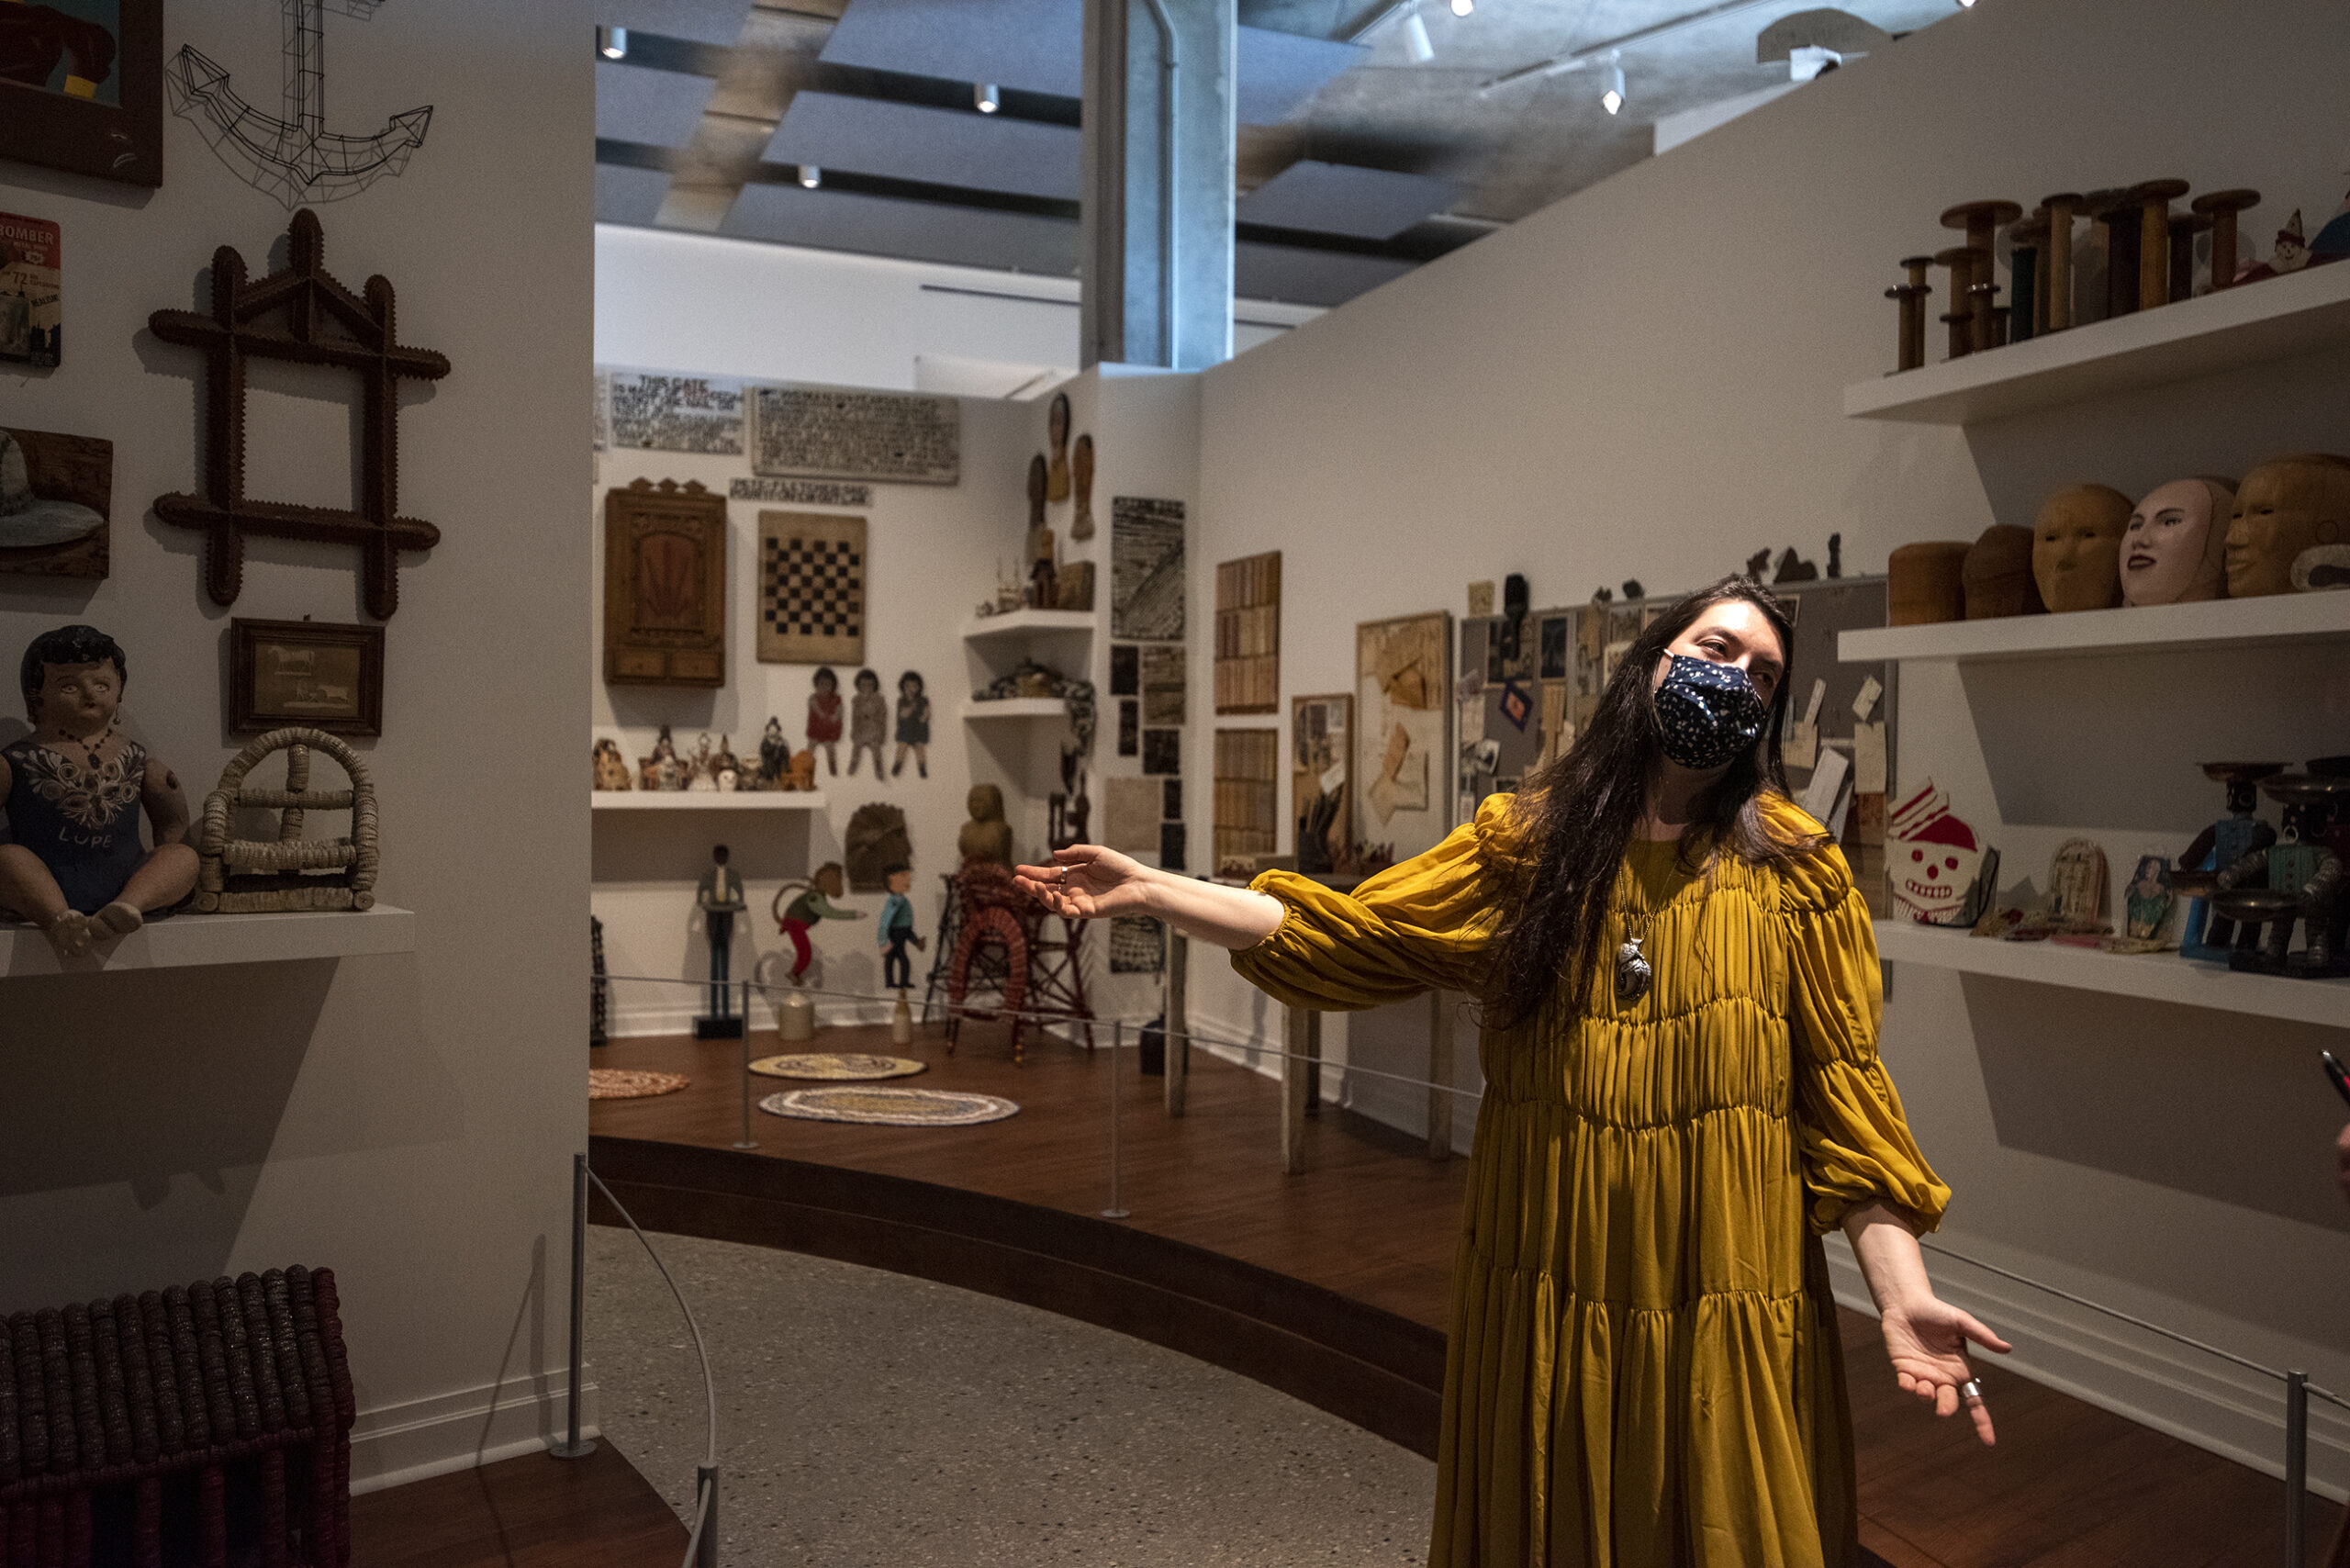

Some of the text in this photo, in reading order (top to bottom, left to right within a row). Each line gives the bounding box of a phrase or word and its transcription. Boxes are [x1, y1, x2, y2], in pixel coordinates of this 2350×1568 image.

[0, 225, 54, 245] BOMBER
[13, 271, 28, 285] 72
[58, 826, 113, 848] LUPE
